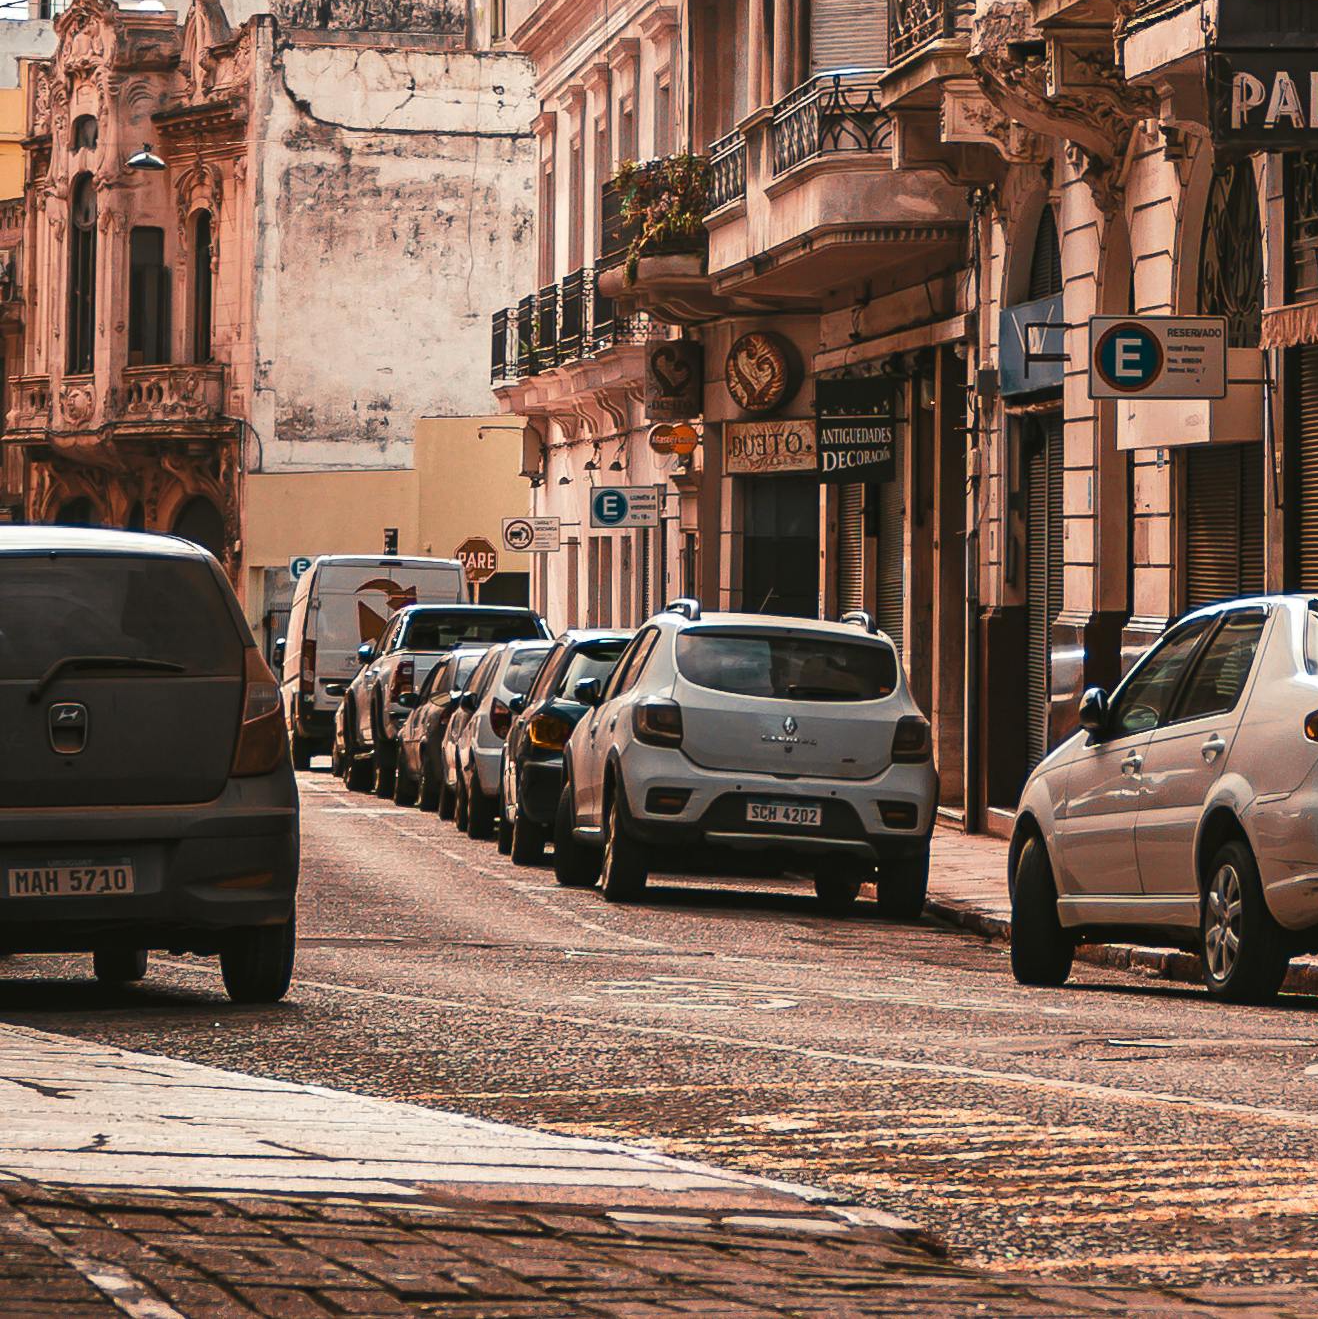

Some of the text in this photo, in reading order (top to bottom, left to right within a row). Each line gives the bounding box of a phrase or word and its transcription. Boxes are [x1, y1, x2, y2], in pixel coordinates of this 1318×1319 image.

[1167, 327, 1222, 339] RESERVADO
[1115, 338, 1143, 377] E
[822, 446, 891, 472] DECORACIÓN
[603, 496, 618, 516] E
[458, 552, 495, 569] PARE
[751, 804, 818, 824] SCH 4202
[15, 868, 127, 893] MAH 5710
